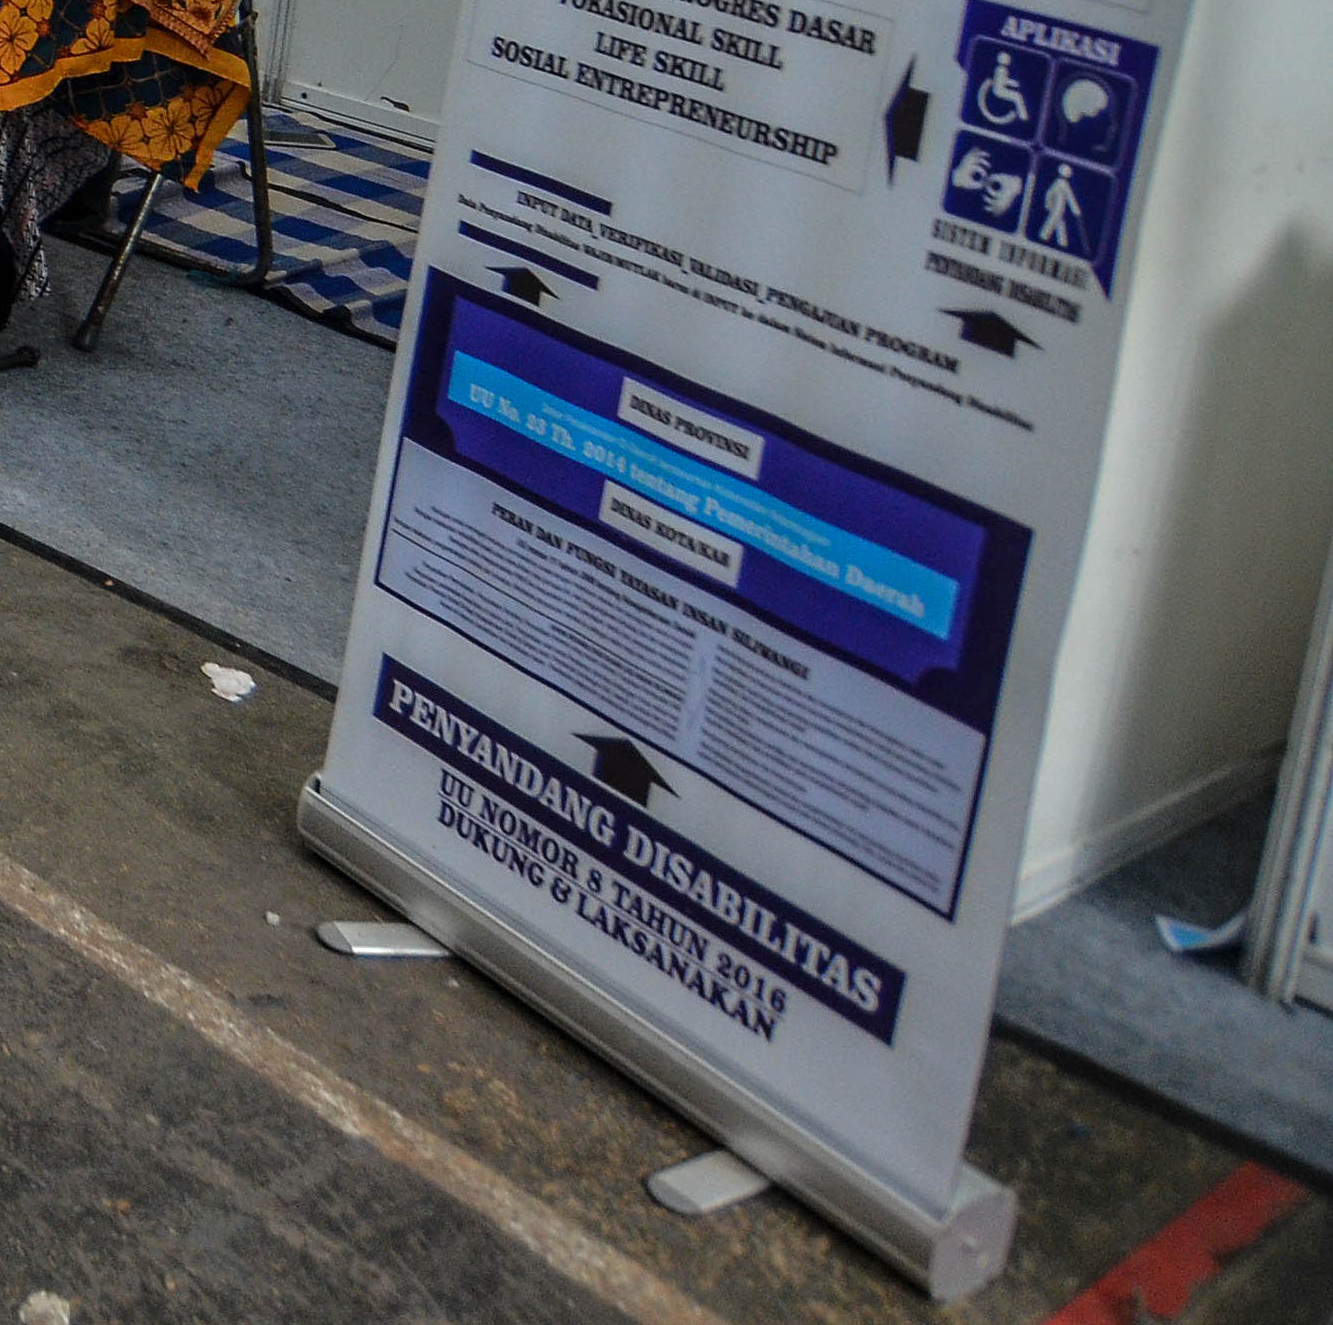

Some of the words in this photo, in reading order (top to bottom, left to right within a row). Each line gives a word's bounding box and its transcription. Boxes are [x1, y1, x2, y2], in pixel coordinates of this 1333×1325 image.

[710, 28, 785, 71] SKILL
[788, 7, 878, 57] DASAR
[1000, 15, 1123, 66] APLIKASI
[594, 31, 647, 70] LIFE
[652, 50, 725, 92] SKILL
[490, 34, 571, 80] SOSIAL
[575, 62, 838, 168] ENTREPRENEURSHIP
[517, 190, 559, 219] INPUT
[628, 394, 672, 426] DINAS
[674, 414, 751, 461] PROVINSI
[611, 496, 652, 528] DINAS
[843, 564, 926, 618] Daerah
[388, 678, 618, 848] PENYANDANG
[625, 824, 882, 1014] DISABILITAS
[440, 768, 474, 810] UU
[479, 787, 579, 877] NOMOR
[586, 864, 602, 891] 8
[609, 879, 710, 960] TAHUN
[716, 949, 788, 1016] 2016
[438, 800, 545, 889] DUKUNG
[551, 877, 573, 903] &
[576, 893, 777, 1043] LAKSANAKAN
